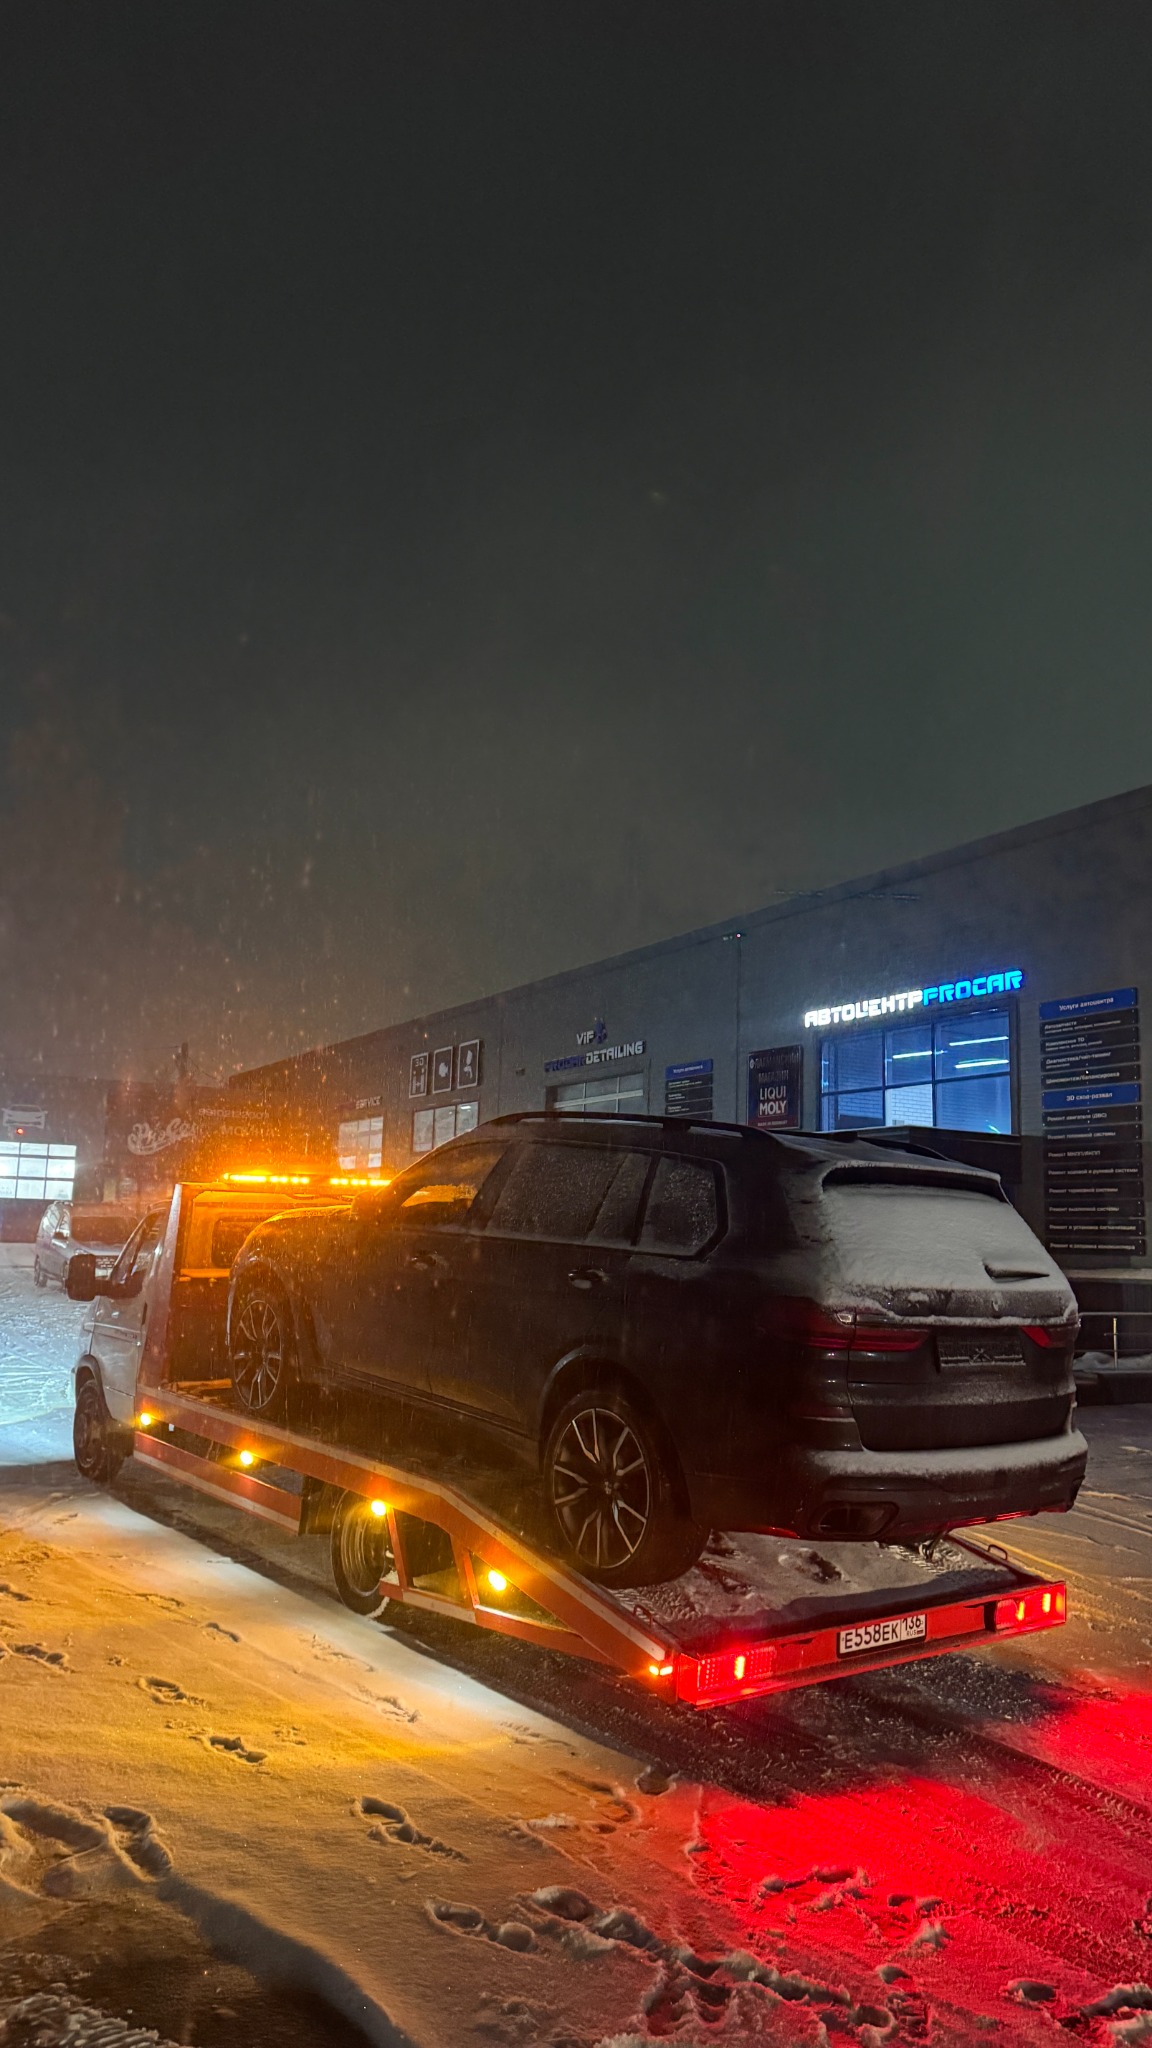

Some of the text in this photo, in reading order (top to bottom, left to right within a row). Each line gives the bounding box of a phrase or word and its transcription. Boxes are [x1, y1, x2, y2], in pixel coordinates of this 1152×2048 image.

[1059, 1003, 1079, 1011] Услуги
[586, 1040, 644, 1065] DETAILING
[760, 1086, 787, 1100] LIQUI
[760, 1101, 787, 1115] MOLY
[902, 1616, 921, 1632] 136
